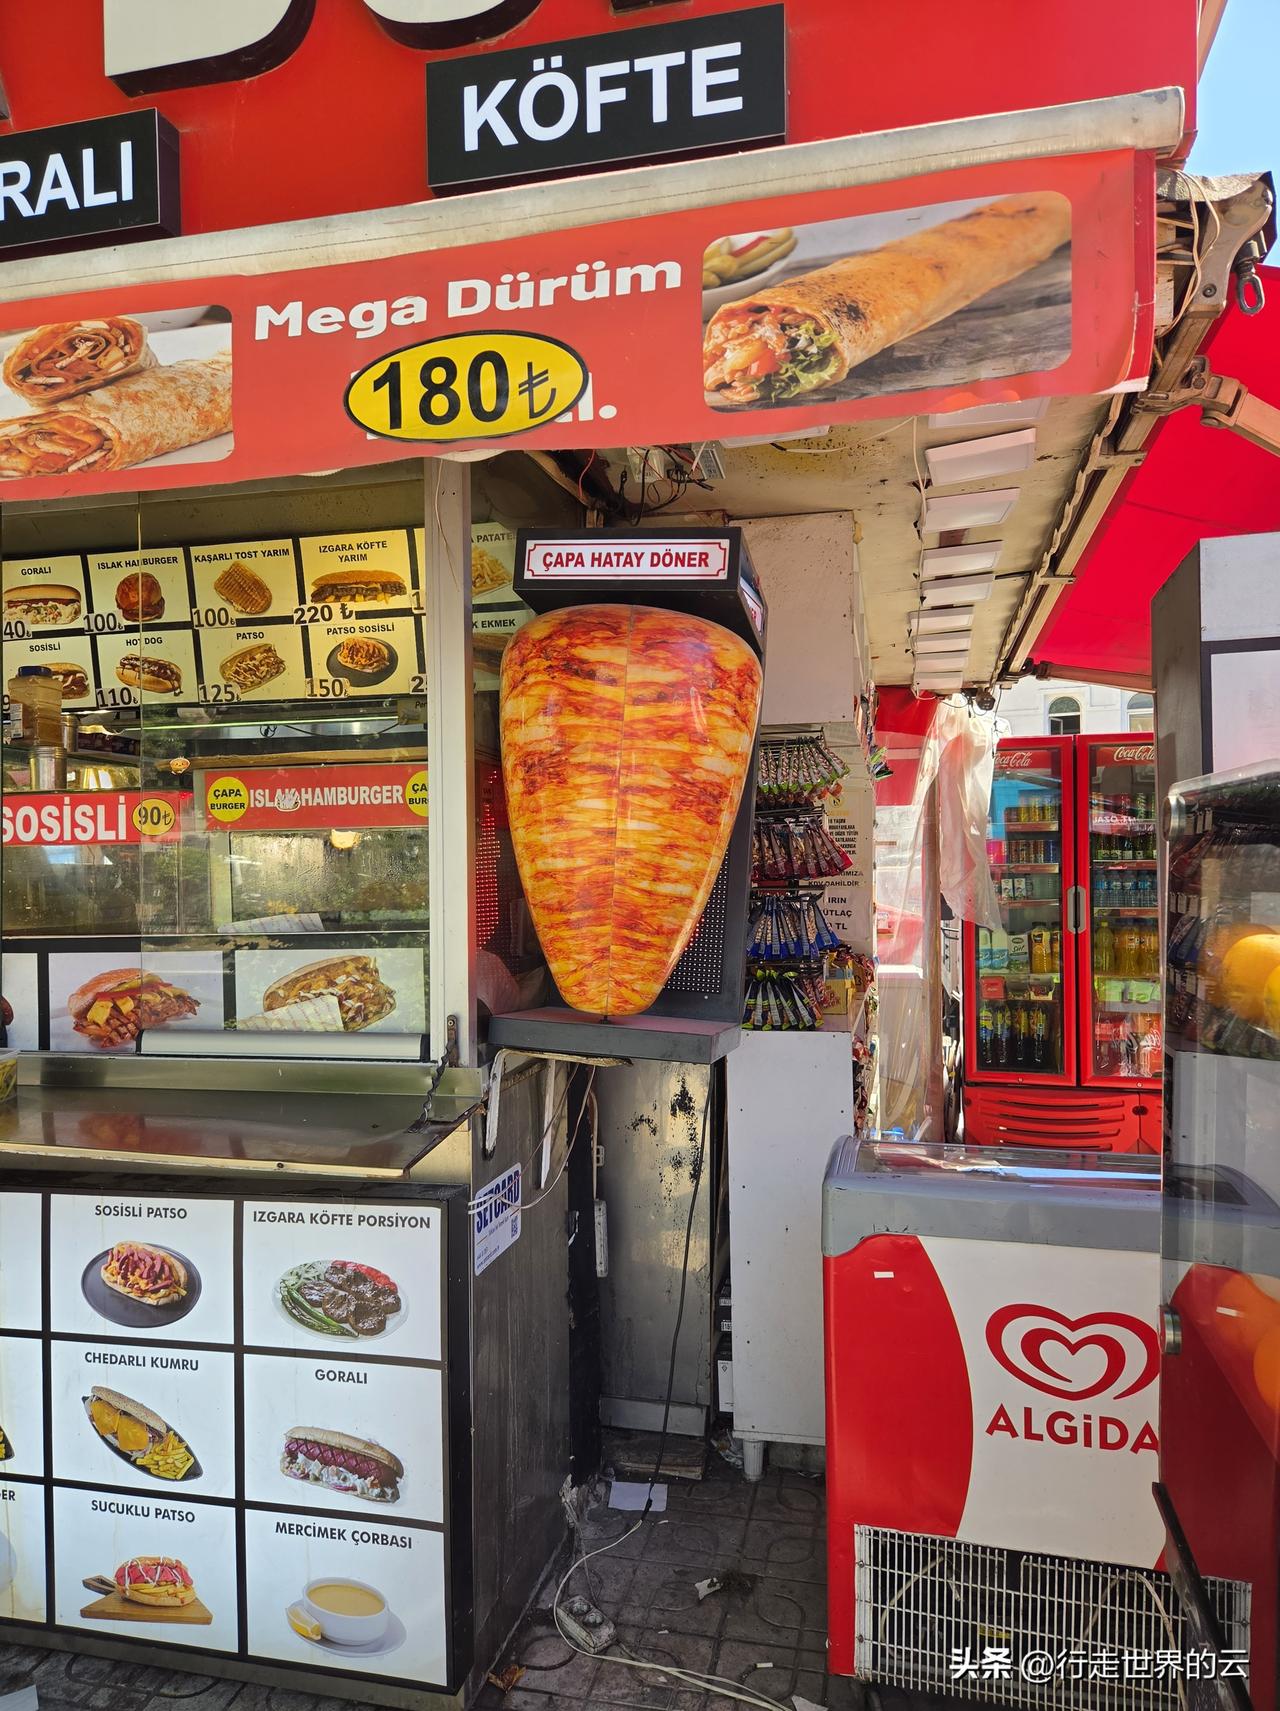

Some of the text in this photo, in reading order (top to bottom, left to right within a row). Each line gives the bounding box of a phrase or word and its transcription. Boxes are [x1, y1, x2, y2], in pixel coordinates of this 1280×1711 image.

[463, 42, 743, 151] KÖFTE
[254, 260, 682, 341] Mega Dürüm
[318, 540, 388, 553] IZGARA KÖFTE
[193, 548, 290, 563] KAŞARLI TOST YARIM
[337, 553, 368, 563] YARIM
[542, 549, 710, 572] ÇAPA HATAY DÖNER
[21, 566, 52, 576] GORALI
[97, 562, 123, 570] ISLAK
[293, 604, 333, 625] 220
[326, 622, 395, 636] PATSO SOSİSLİ
[481, 618, 516, 628] EKMEK
[144, 637, 163, 645] DOG
[236, 631, 265, 641] PATSO
[29, 641, 61, 652] SOSİSLİ
[213, 788, 242, 800] ÇAPA
[300, 785, 404, 807] HAMBURGER
[210, 801, 246, 811] BURGER
[2, 795, 127, 842] SOSİSLİ
[95, 1203, 188, 1219] SOSİSLİ PATSO
[253, 1210, 431, 1228] IZGARA KÖFTE PORSİYON
[84, 1352, 199, 1371] CHEDARLI KUMRU
[315, 1369, 368, 1384] GORALI
[91, 1500, 196, 1523] SUCUKLU PATSO
[275, 1521, 412, 1549] MERCİMEK ÇORBASI
